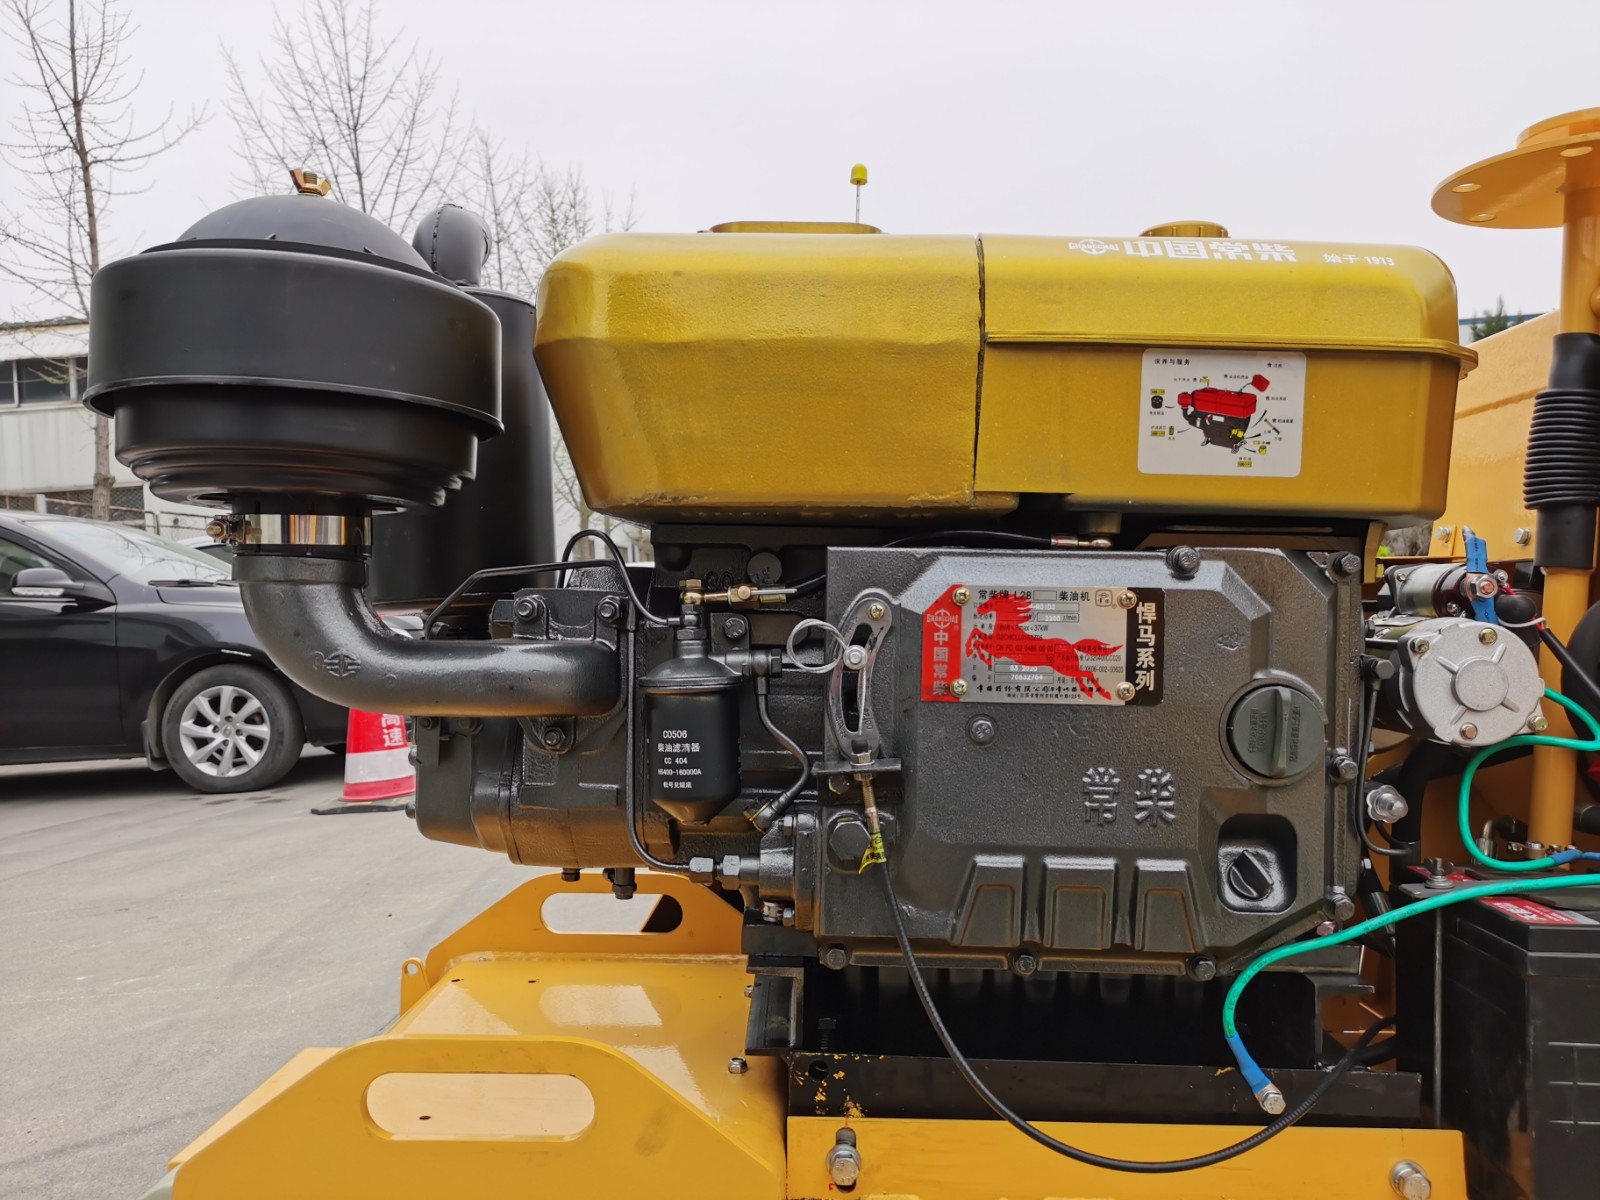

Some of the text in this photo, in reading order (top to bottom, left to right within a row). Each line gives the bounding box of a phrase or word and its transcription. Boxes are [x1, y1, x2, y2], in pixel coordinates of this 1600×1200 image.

[1123, 240, 1296, 262] 中国常柴
[1364, 256, 1394, 266] 1913
[1058, 590, 1090, 602] 柴油机
[1135, 602, 1157, 691] 悍马系列
[932, 629, 949, 695] 中国常柴
[674, 757, 688, 765] 404
[1081, 766, 1176, 828] 常柴
